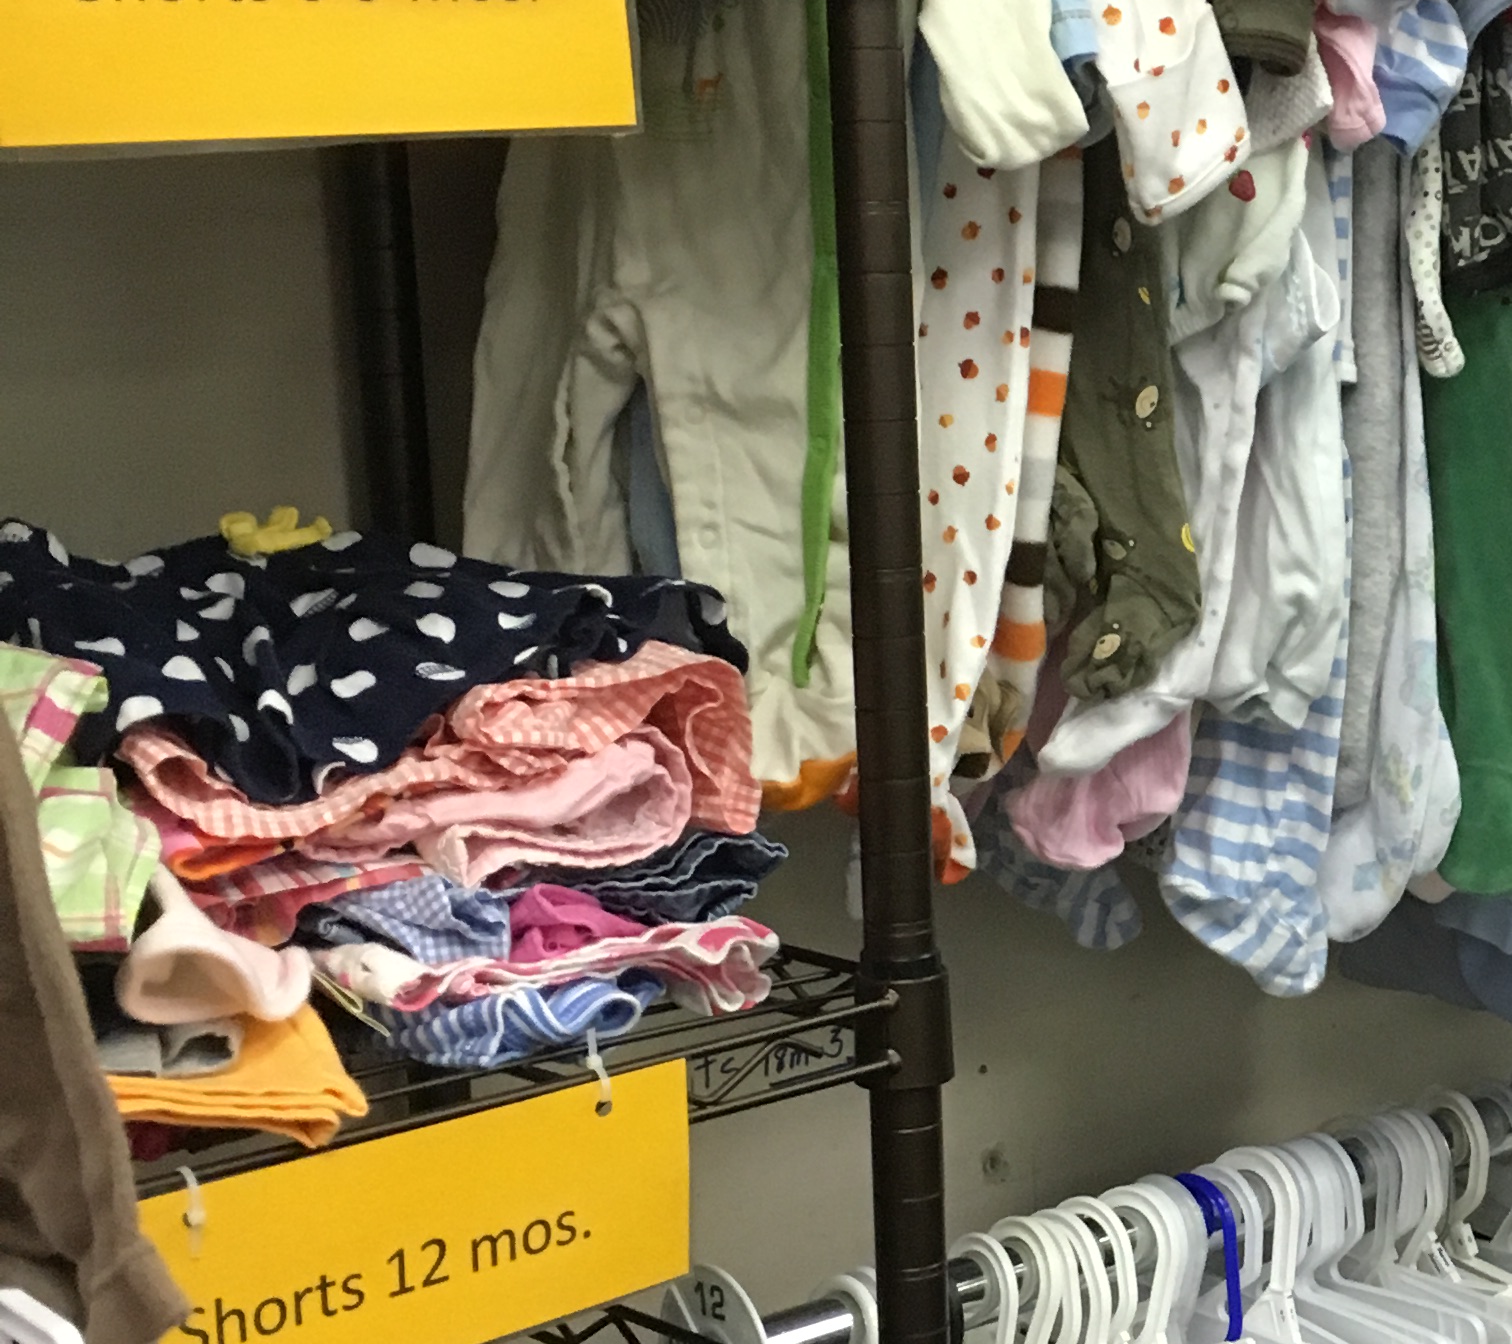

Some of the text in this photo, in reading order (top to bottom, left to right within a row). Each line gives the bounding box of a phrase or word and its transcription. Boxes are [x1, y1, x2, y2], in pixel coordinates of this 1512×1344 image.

[387, 1239, 451, 1299] 12
[470, 1209, 594, 1274] mos.
[694, 1280, 727, 1322] 12
